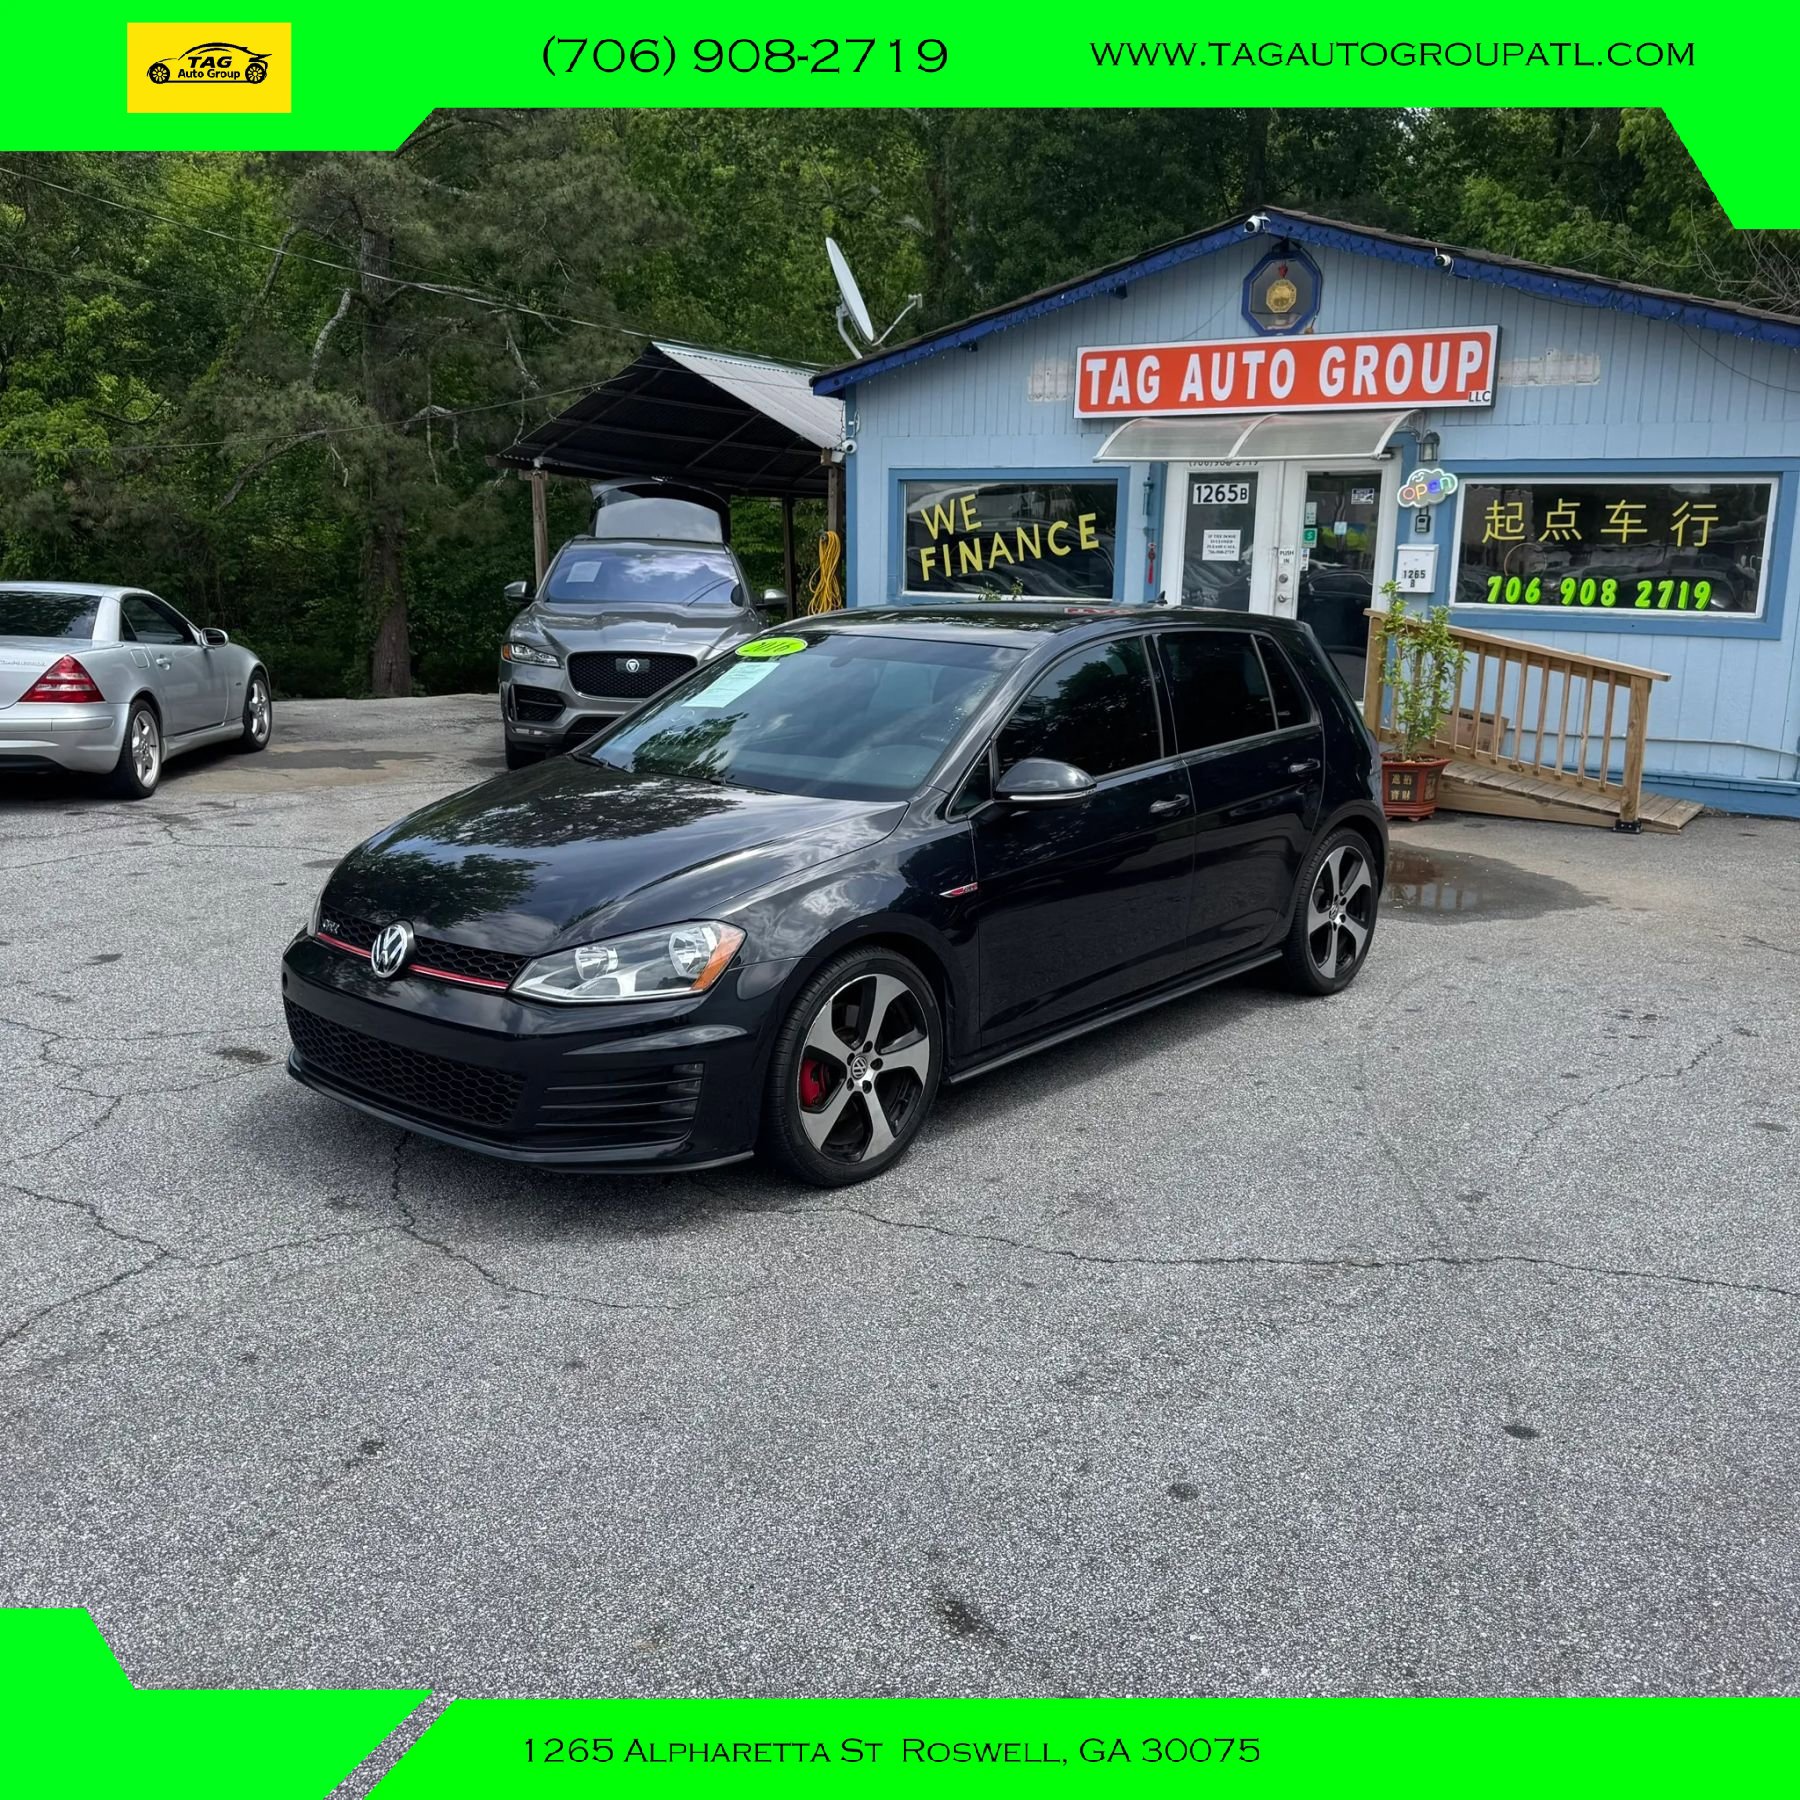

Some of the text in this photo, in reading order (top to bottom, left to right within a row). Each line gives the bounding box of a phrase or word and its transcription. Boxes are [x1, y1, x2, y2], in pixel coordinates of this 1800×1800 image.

[1085, 340, 1483, 406] TAG AUTO GROUP
[1468, 390, 1491, 403] LLC
[920, 493, 982, 540] WE
[1482, 498, 1719, 547] 起点车行
[920, 513, 1099, 582] FINANCE
[1403, 569, 1426, 580] 1265
[1487, 575, 1712, 610] 706 908 2719
